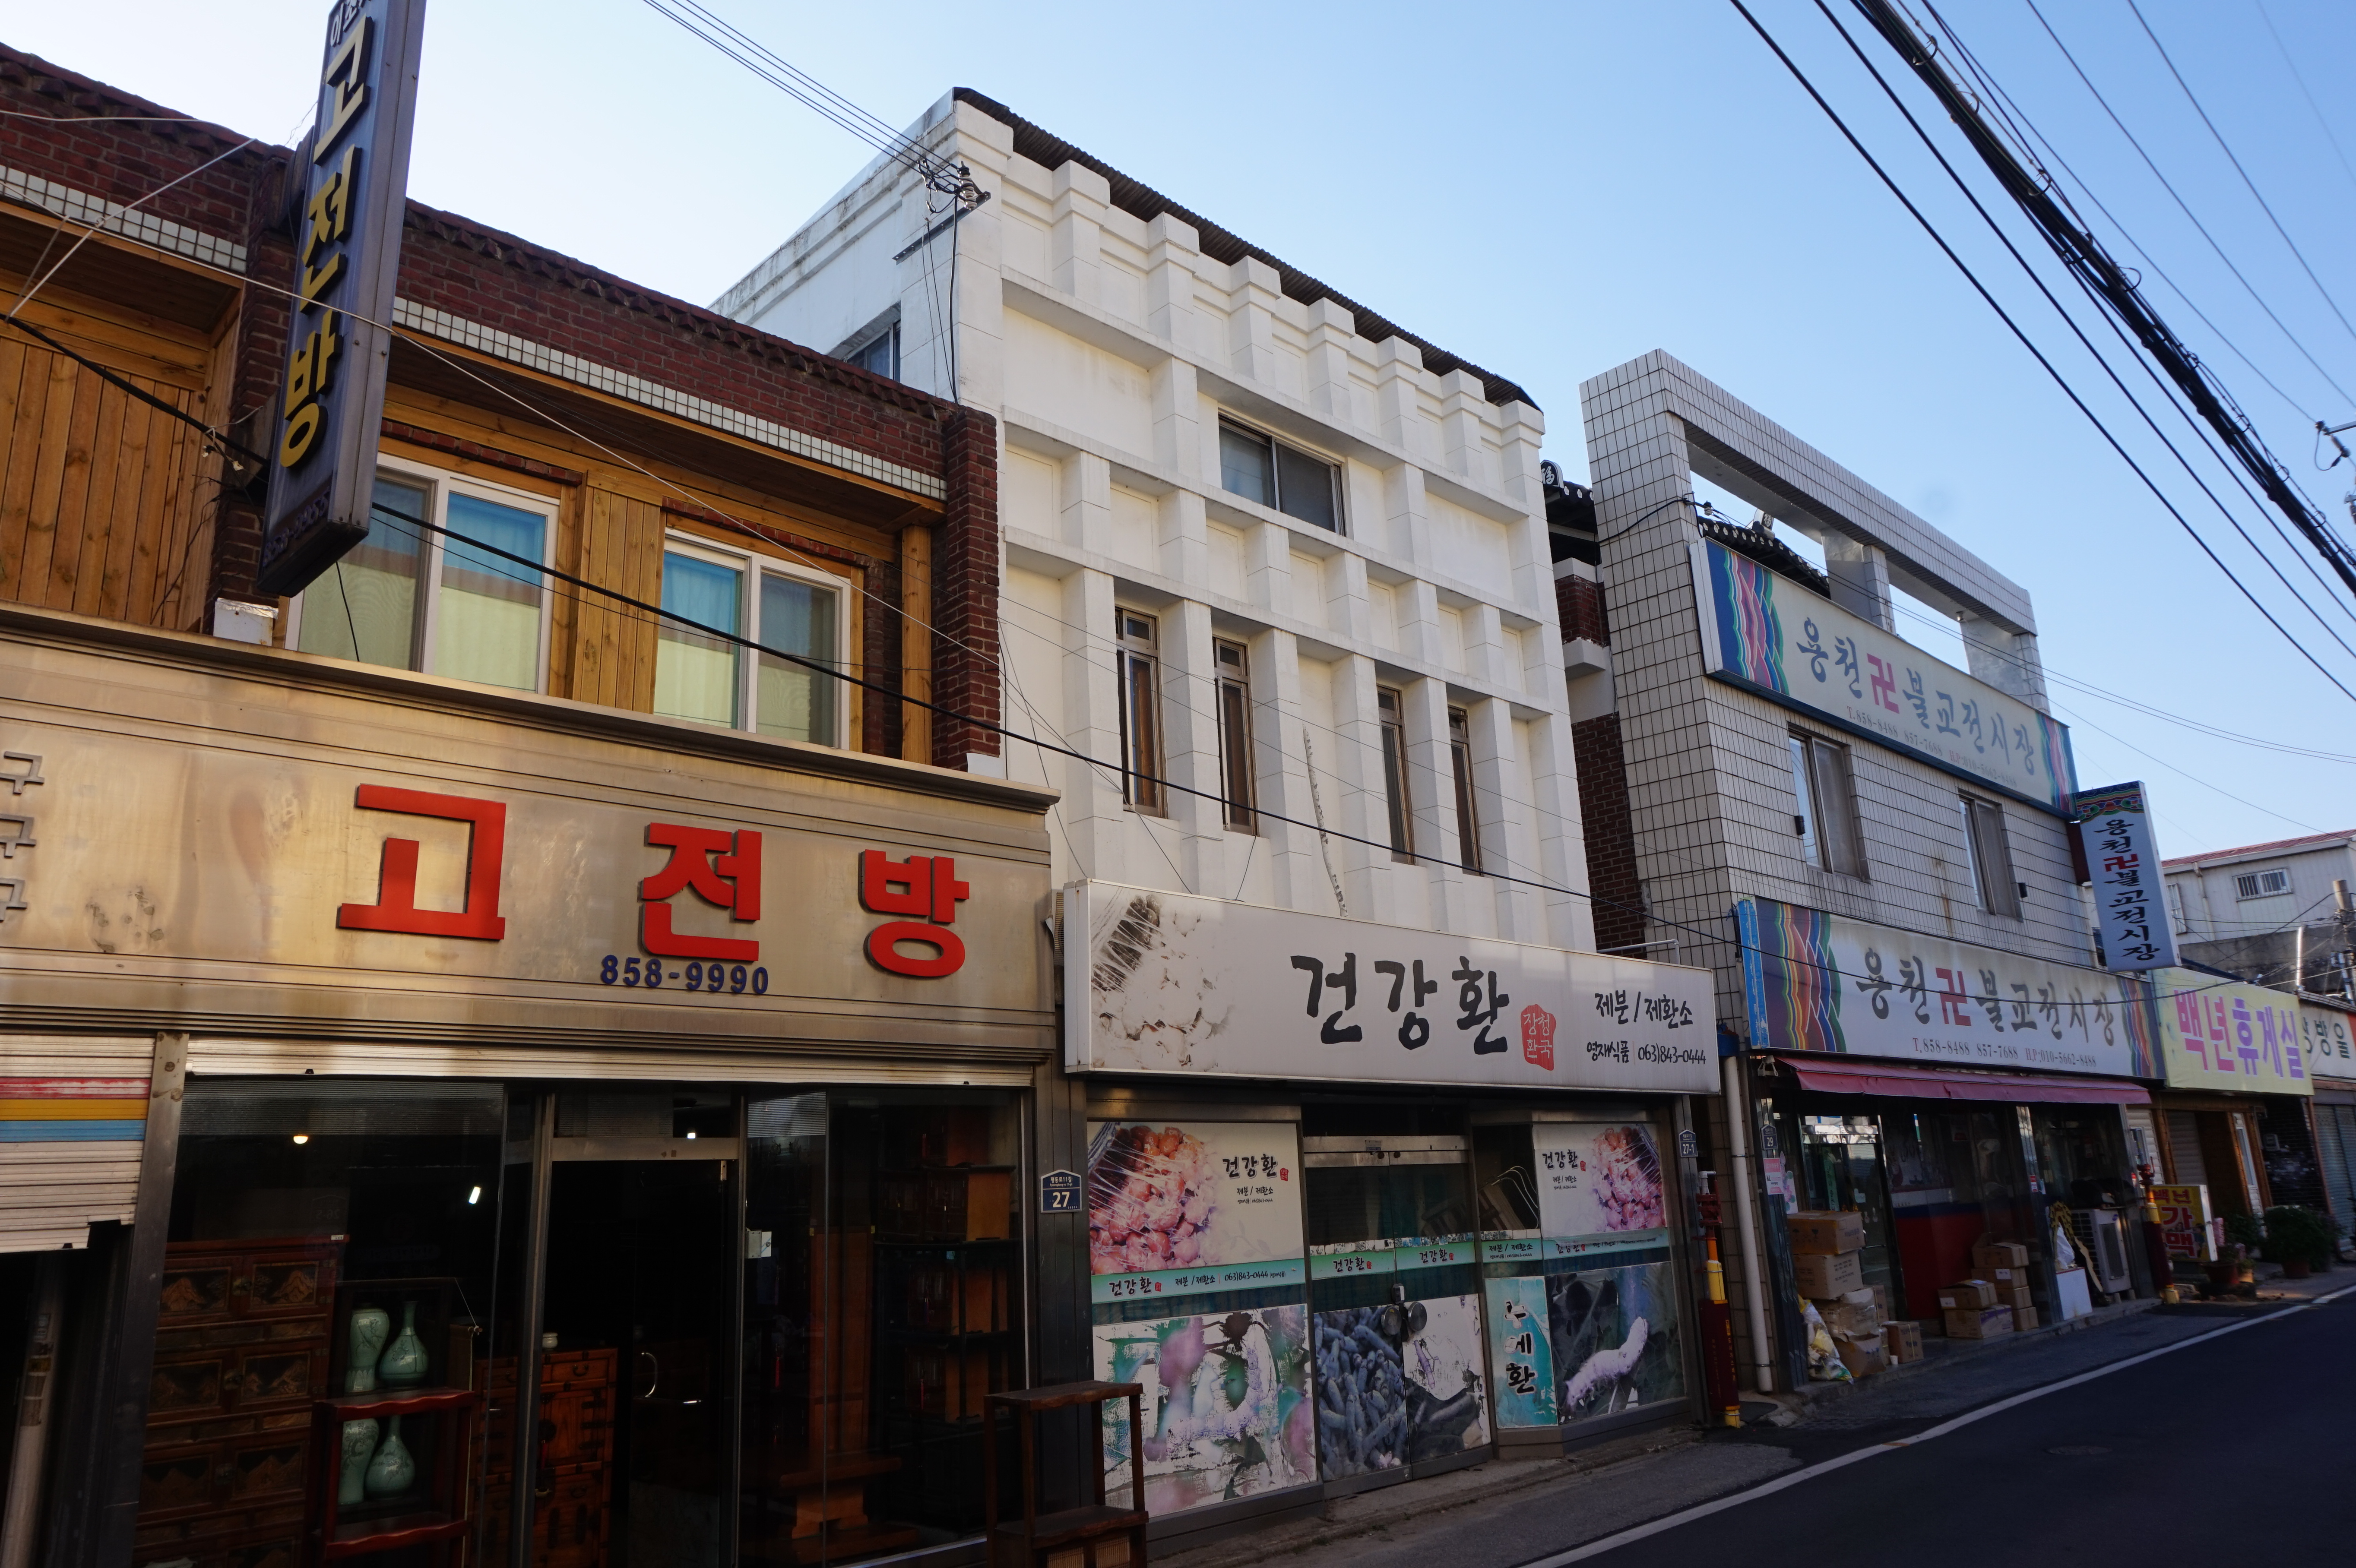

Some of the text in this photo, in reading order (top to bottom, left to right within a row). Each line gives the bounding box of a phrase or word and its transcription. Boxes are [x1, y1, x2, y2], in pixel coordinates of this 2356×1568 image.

[280, 14, 367, 468] 고전방
[338, 783, 969, 977] 고전방
[600, 955, 769, 995] 858-9990
[1291, 952, 1510, 1056] 건강환
[1595, 990, 1629, 1024] 제분
[1644, 994, 1693, 1029] 제환소
[1586, 1040, 1706, 1065] 영재식품 063)843-0444
[1977, 1044, 2018, 1059] 857-7688
[1682, 1143, 1694, 1154] 27-1
[1766, 1137, 1773, 1147] 29
[1222, 1154, 1277, 1178] 건강환
[1542, 1149, 1578, 1169] 건강환
[1237, 1186, 1249, 1196] 제분
[1255, 1185, 1274, 1195] 제환소
[1052, 1192, 1070, 1208] 27
[1419, 1248, 1448, 1263] 건강환
[1488, 1244, 1503, 1252] 제분
[1511, 1242, 1533, 1252] 제환소
[1333, 1255, 1365, 1272] 건강환
[1109, 1276, 1152, 1296] 건강환
[1175, 1276, 1188, 1287] 제분
[1224, 1271, 1269, 1281] 063)843-0444
